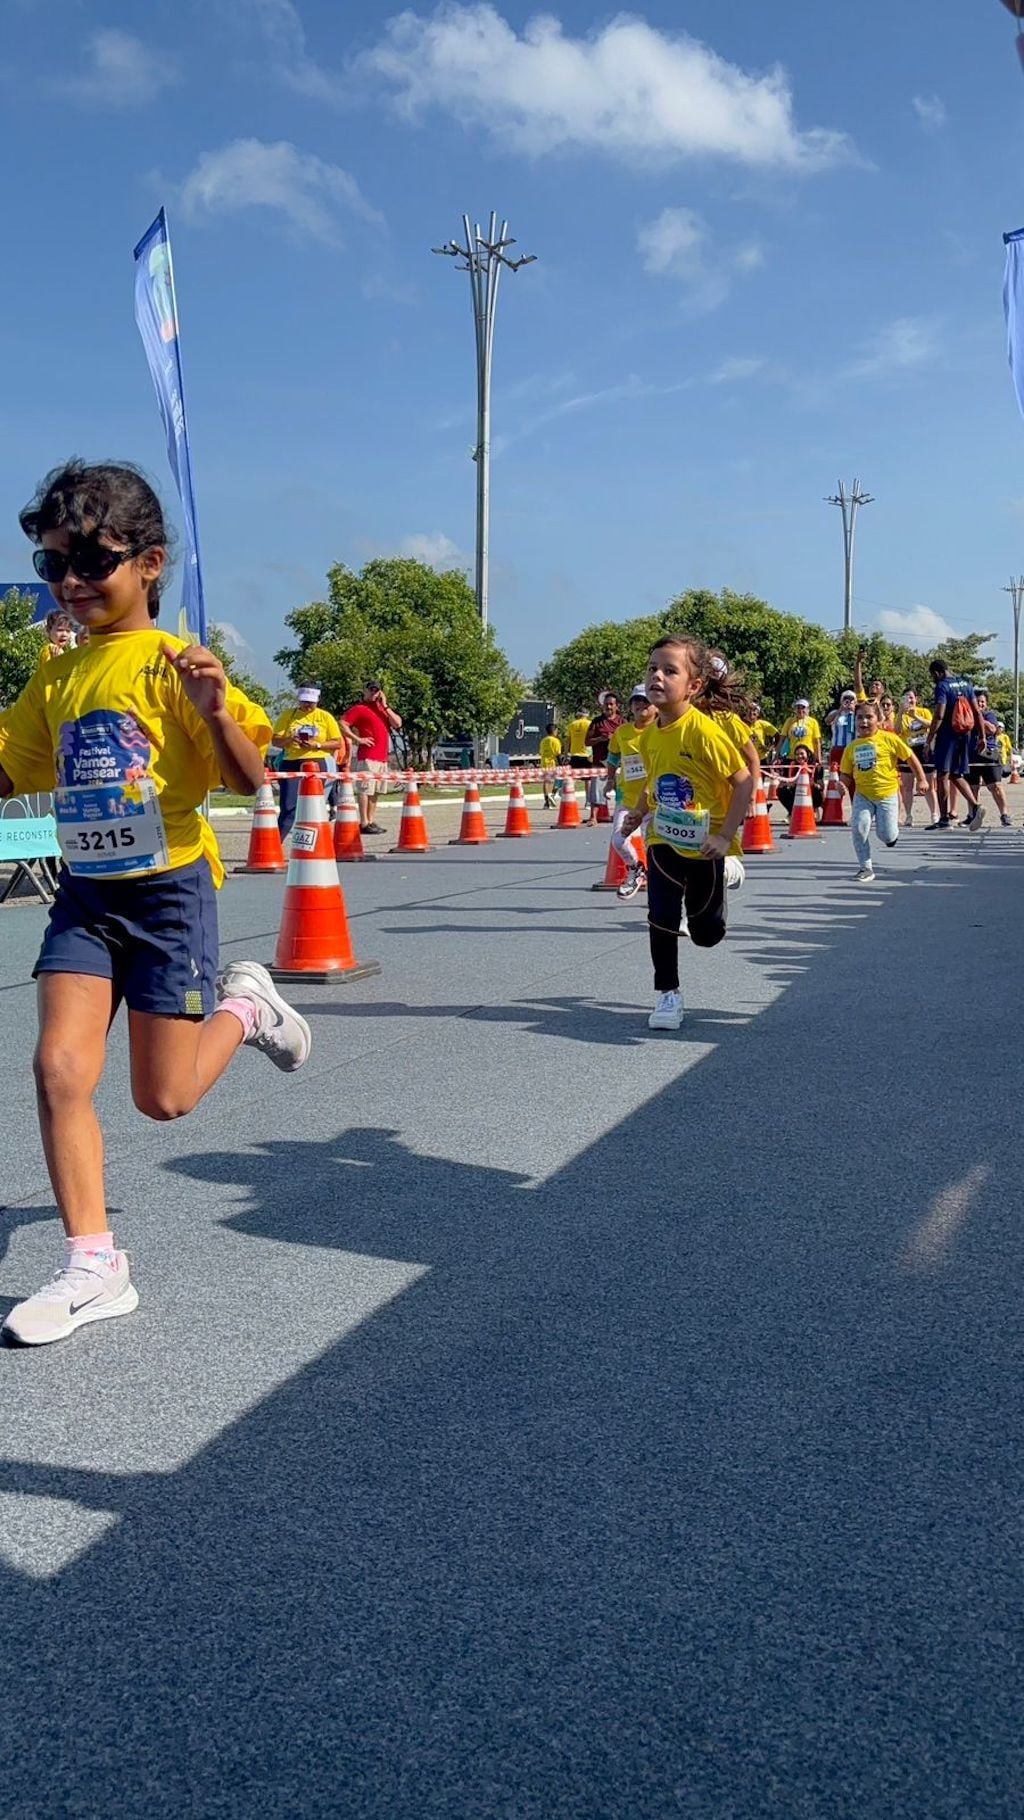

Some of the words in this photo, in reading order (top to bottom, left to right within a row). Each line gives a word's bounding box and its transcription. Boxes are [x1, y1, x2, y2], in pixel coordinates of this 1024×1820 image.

[79, 746, 111, 756] Festival
[73, 757, 116, 769] Vamos
[73, 768, 121, 780] Passear
[665, 825, 696, 839] 3003
[78, 827, 135, 851] 3215
